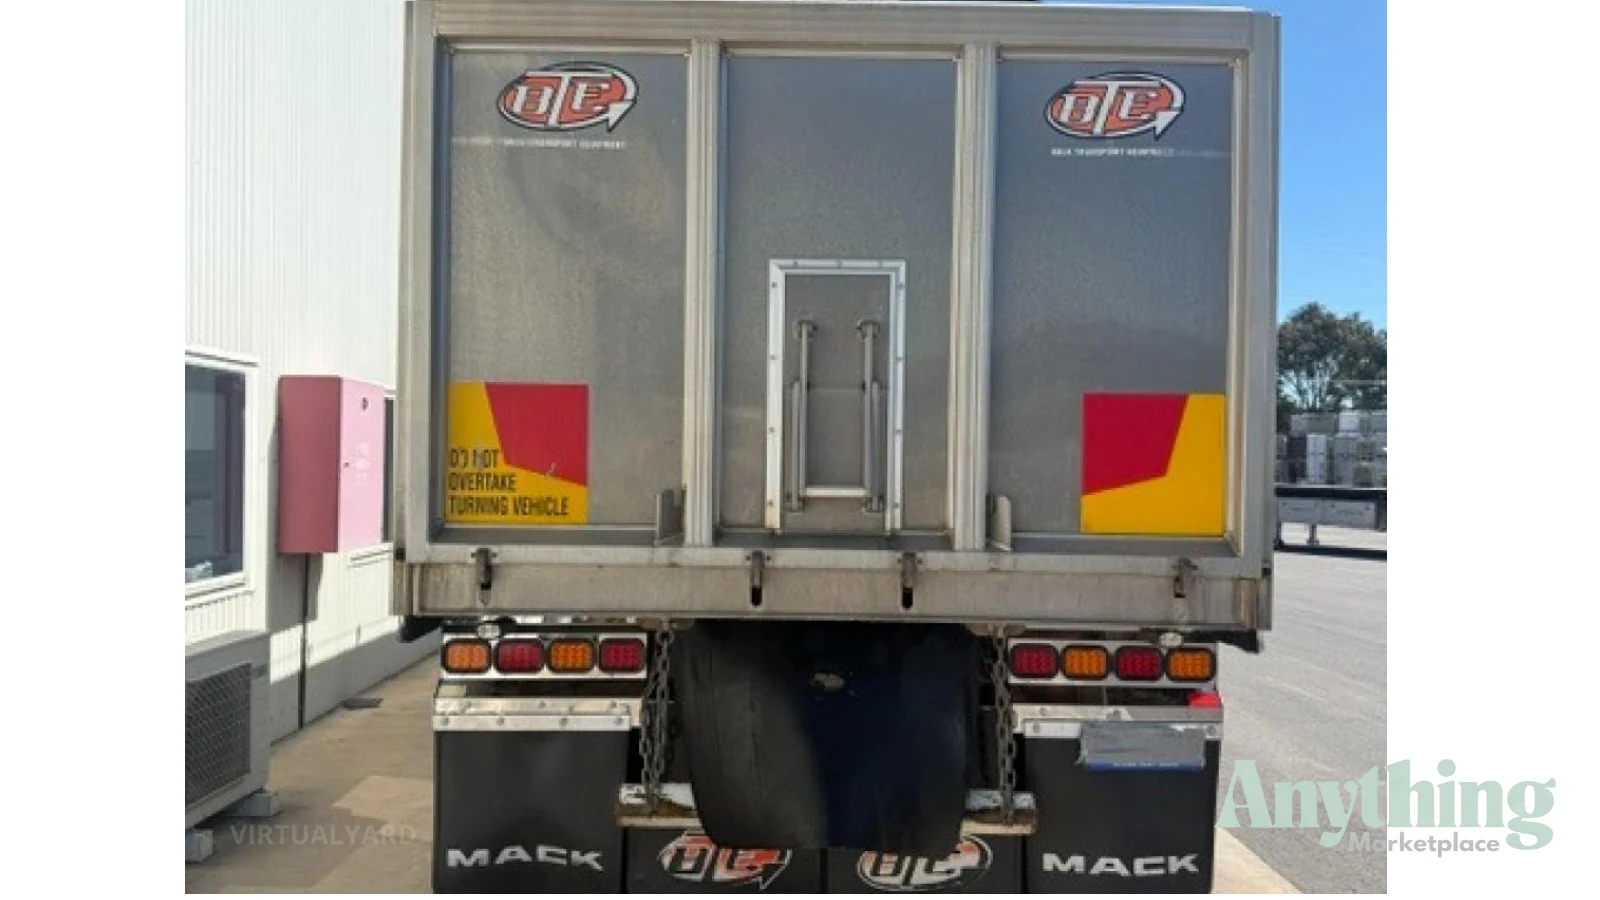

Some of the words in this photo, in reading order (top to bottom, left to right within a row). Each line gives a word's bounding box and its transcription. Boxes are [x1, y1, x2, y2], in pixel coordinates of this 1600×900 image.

[449, 472, 516, 491] OVERTAKE
[449, 495, 508, 516] TURNING
[511, 496, 570, 516] VEHICLE
[447, 845, 604, 871] MACK
[1042, 852, 1200, 877] MACK
